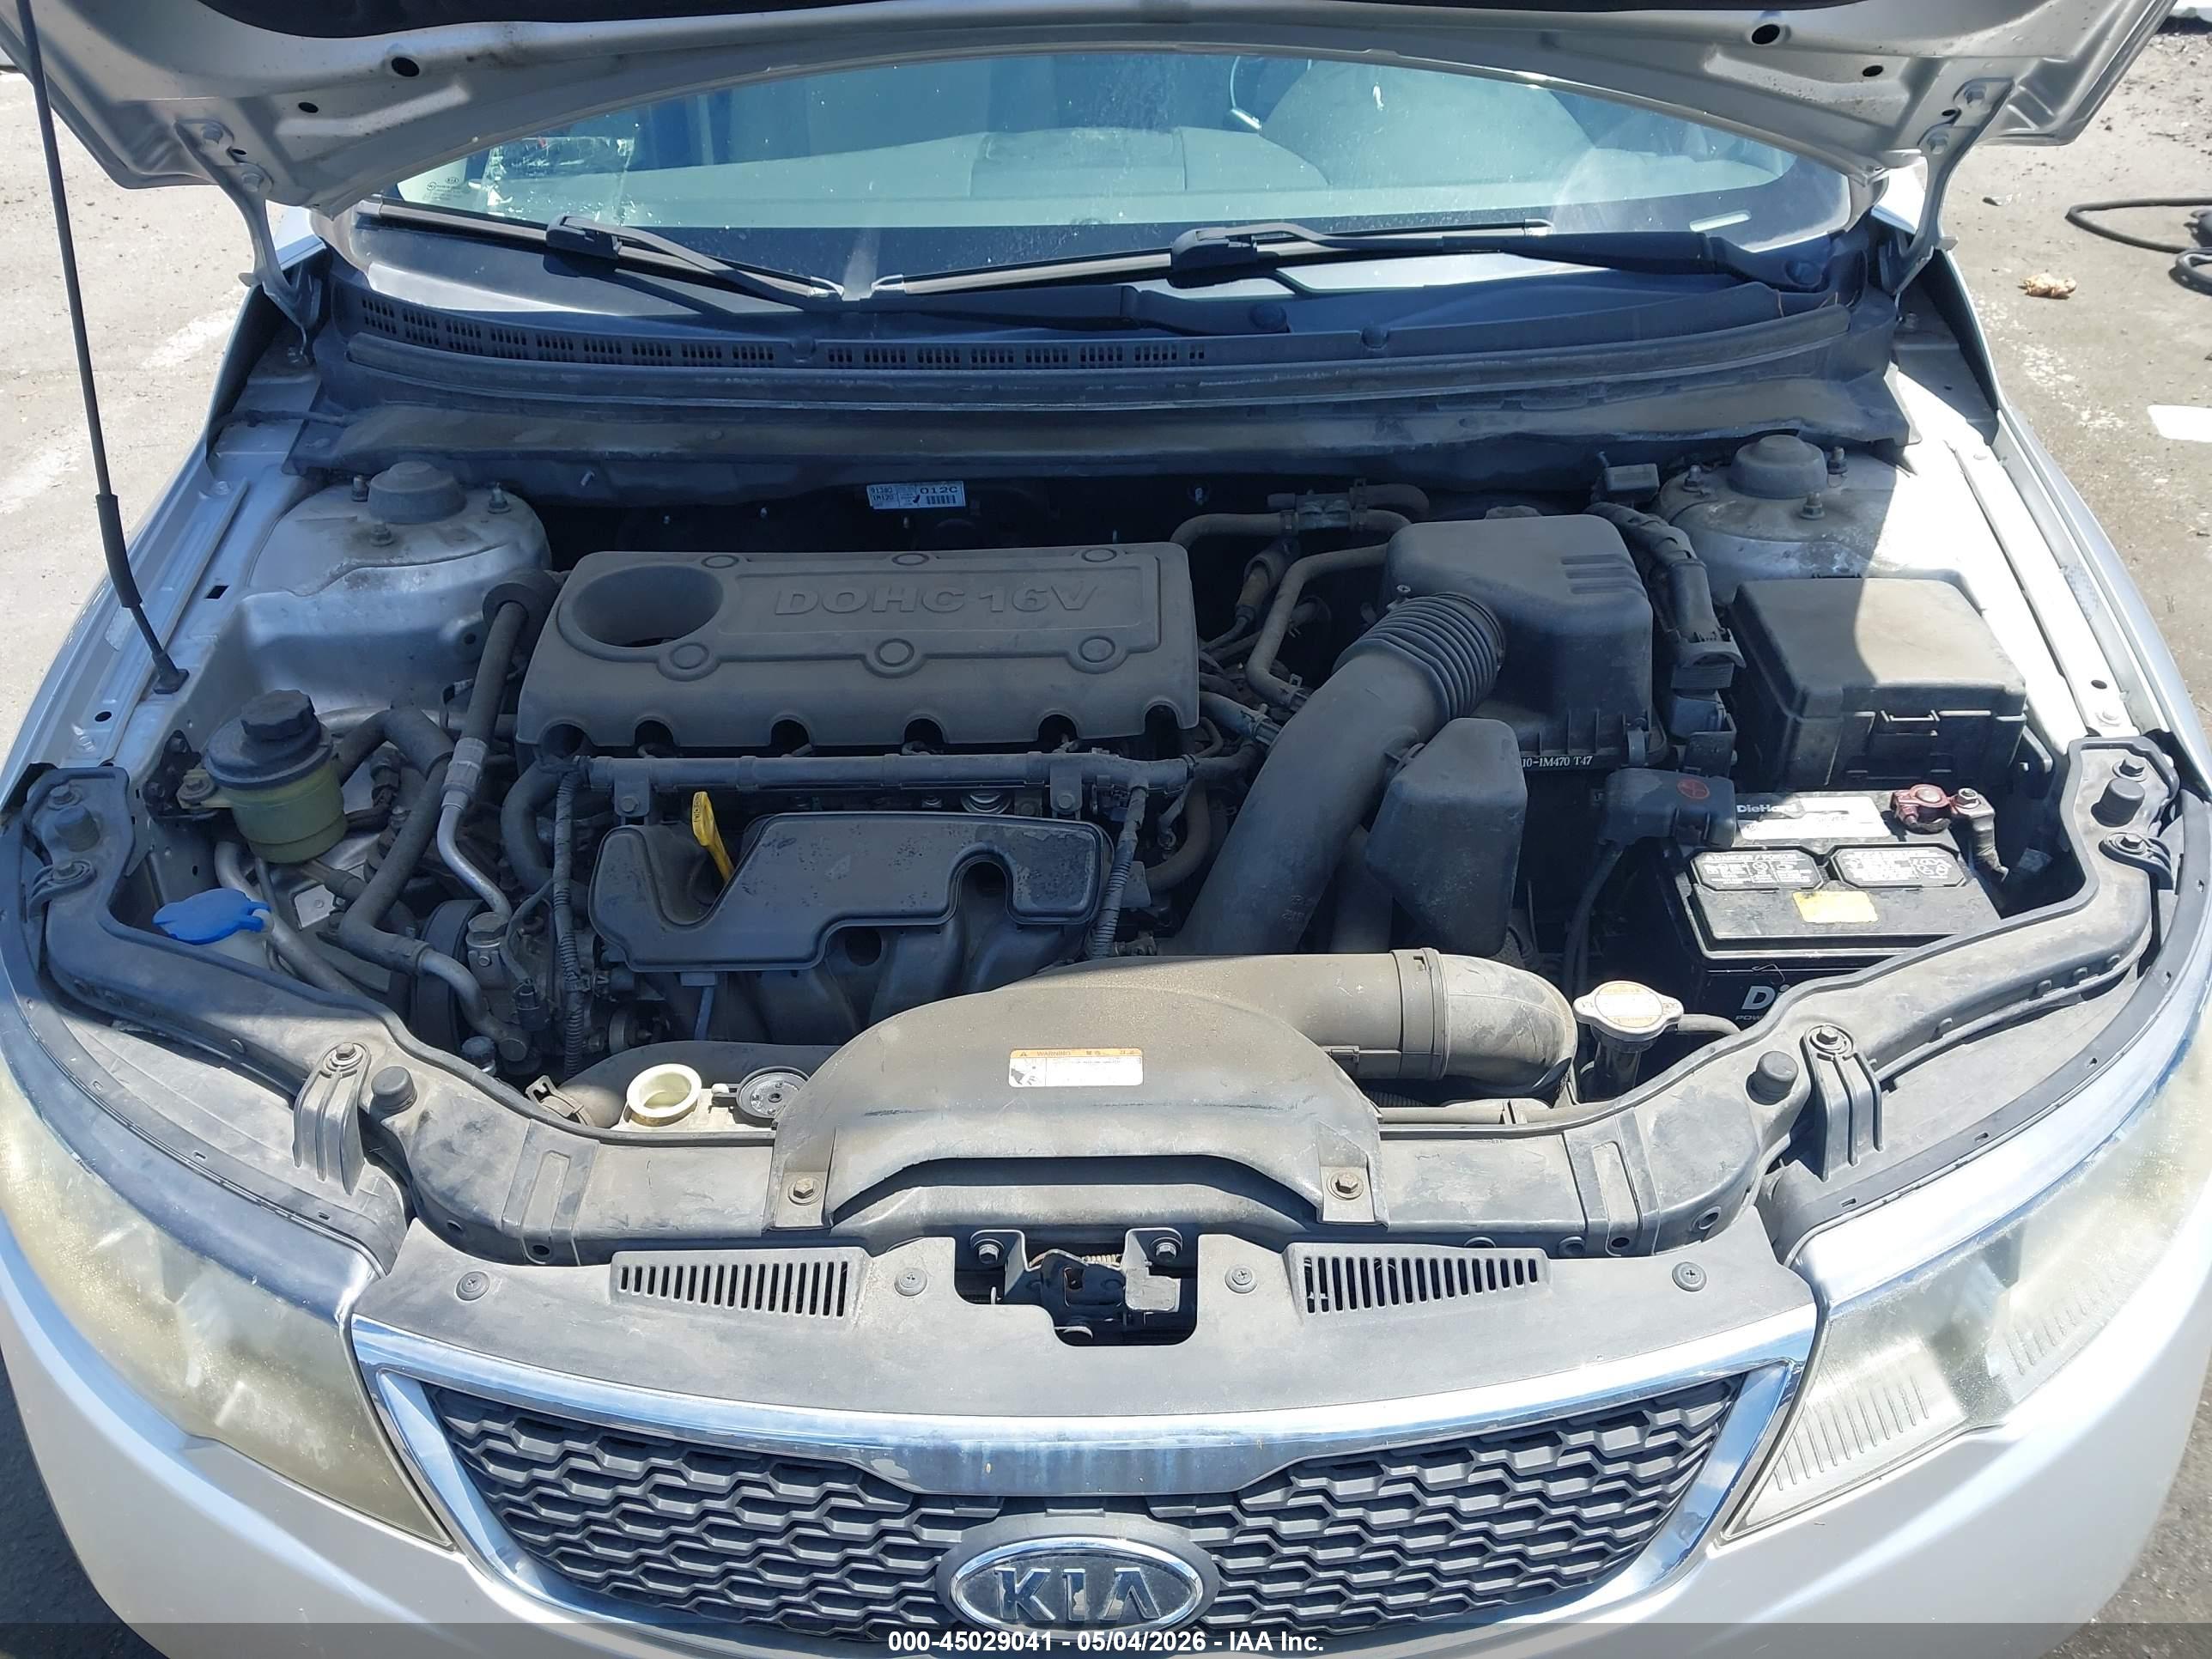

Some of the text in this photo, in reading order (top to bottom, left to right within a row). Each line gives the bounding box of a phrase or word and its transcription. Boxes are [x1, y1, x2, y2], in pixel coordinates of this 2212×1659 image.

[920, 486, 958, 495] 012C
[775, 585, 1097, 616] DOHC 16V
[1574, 756, 1593, 765] T47
[994, 1567, 1161, 1621] KIA
